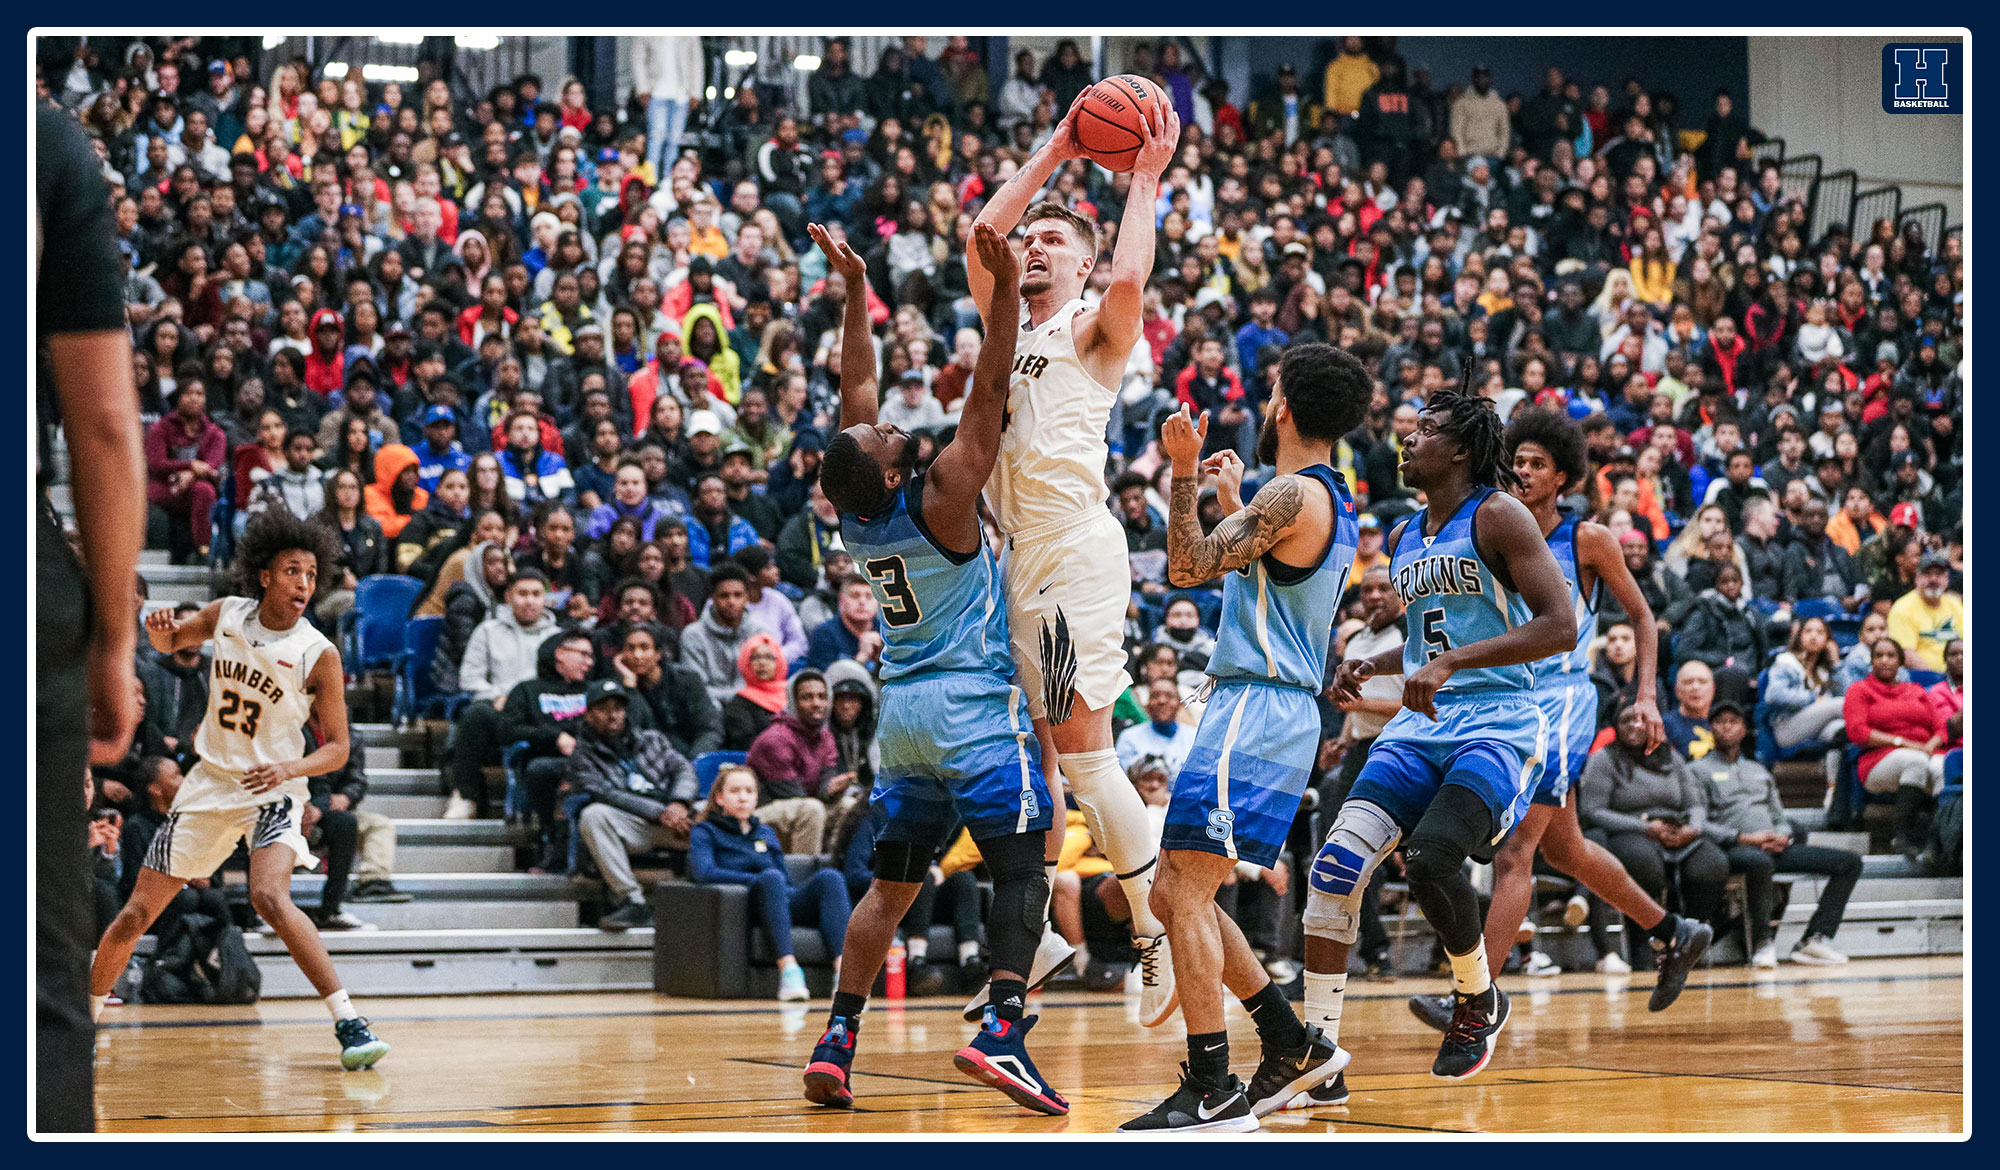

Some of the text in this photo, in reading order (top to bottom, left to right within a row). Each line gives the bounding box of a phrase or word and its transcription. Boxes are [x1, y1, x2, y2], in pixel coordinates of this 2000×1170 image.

[865, 554, 923, 629] 3
[1423, 607, 1452, 663] 5
[218, 688, 262, 739] 23
[1020, 789, 1040, 819] 3
[1206, 807, 1236, 842] S
